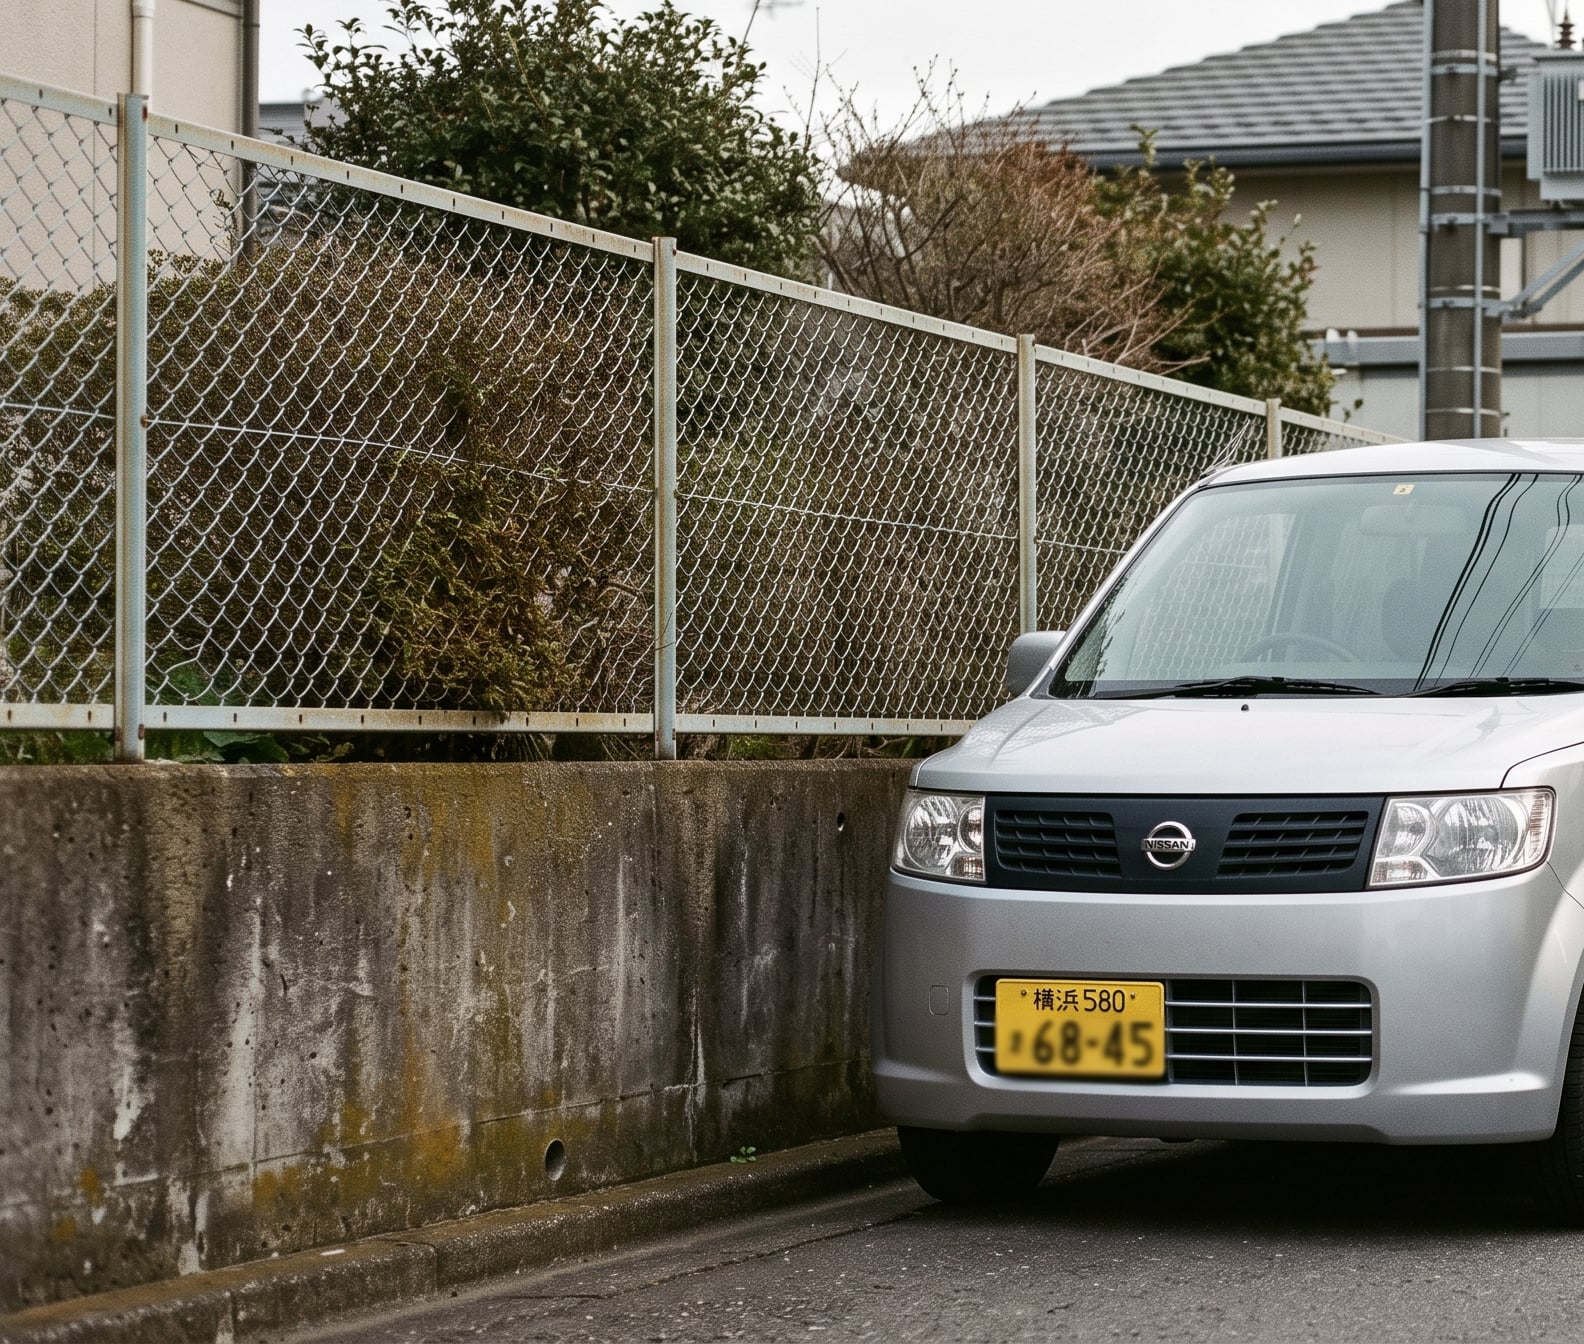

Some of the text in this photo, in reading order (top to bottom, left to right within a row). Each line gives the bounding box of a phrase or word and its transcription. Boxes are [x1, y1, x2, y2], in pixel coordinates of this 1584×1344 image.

[1145, 840, 1189, 849] NISSAN
[1033, 988, 1126, 1013] 横浜 580
